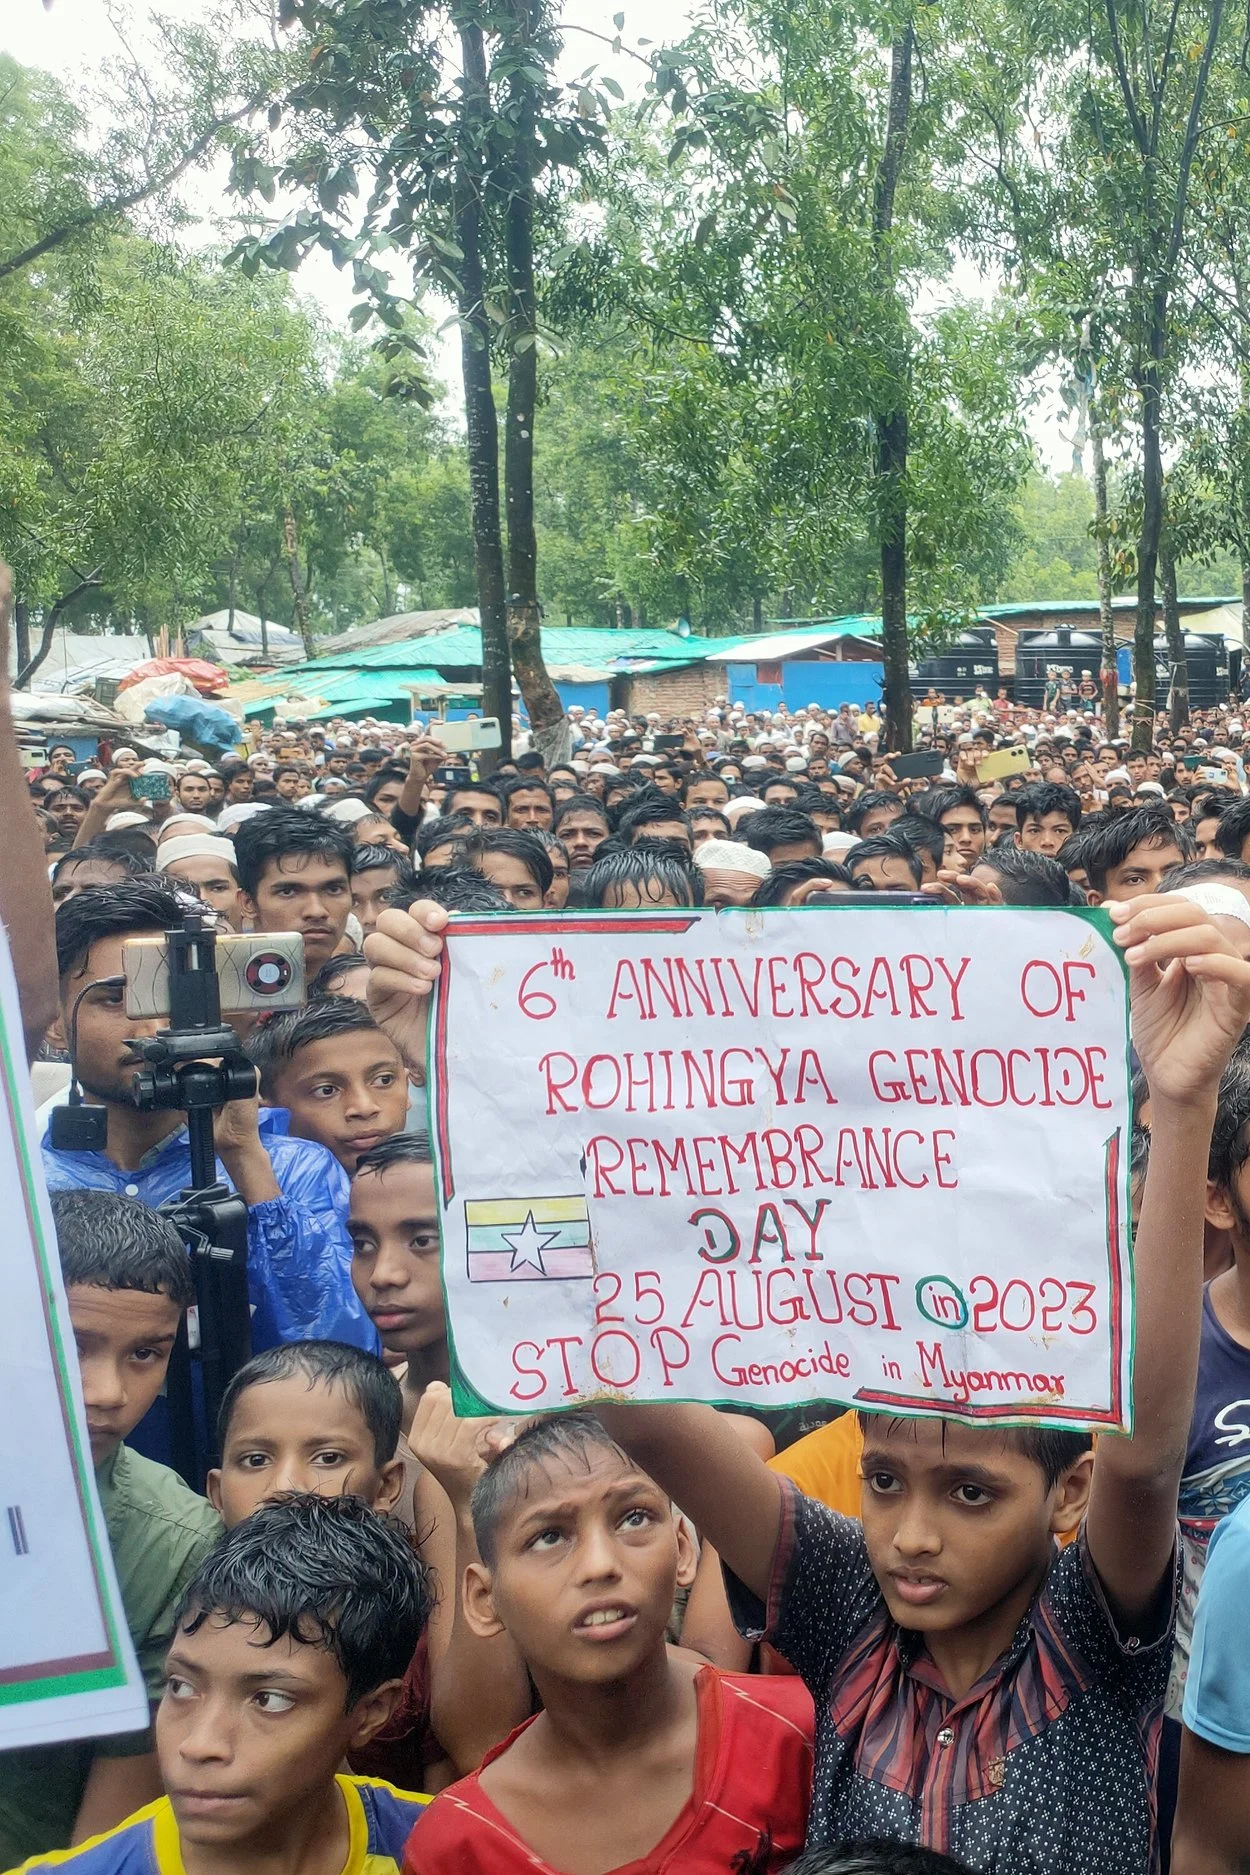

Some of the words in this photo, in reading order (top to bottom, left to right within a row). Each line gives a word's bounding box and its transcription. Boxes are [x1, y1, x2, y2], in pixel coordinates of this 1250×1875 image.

[519, 948, 576, 1020] 6th
[608, 952, 970, 1021] ANNIVERSARY
[1021, 959, 1095, 1021] OF
[539, 1048, 837, 1115] ROHINGYA
[869, 1047, 1112, 1106] GENOCIDE
[587, 1124, 957, 1198] REMEMBRANCE
[690, 1200, 827, 1264] DAY
[593, 1271, 664, 1325] 25
[681, 1268, 901, 1331] AUGUST
[928, 1284, 961, 1321] in
[969, 1276, 1096, 1335] 2023
[511, 1326, 689, 1400] STOP
[712, 1334, 851, 1386] Genocide
[881, 1354, 902, 1380] in
[916, 1341, 1065, 1402] Myanmar
